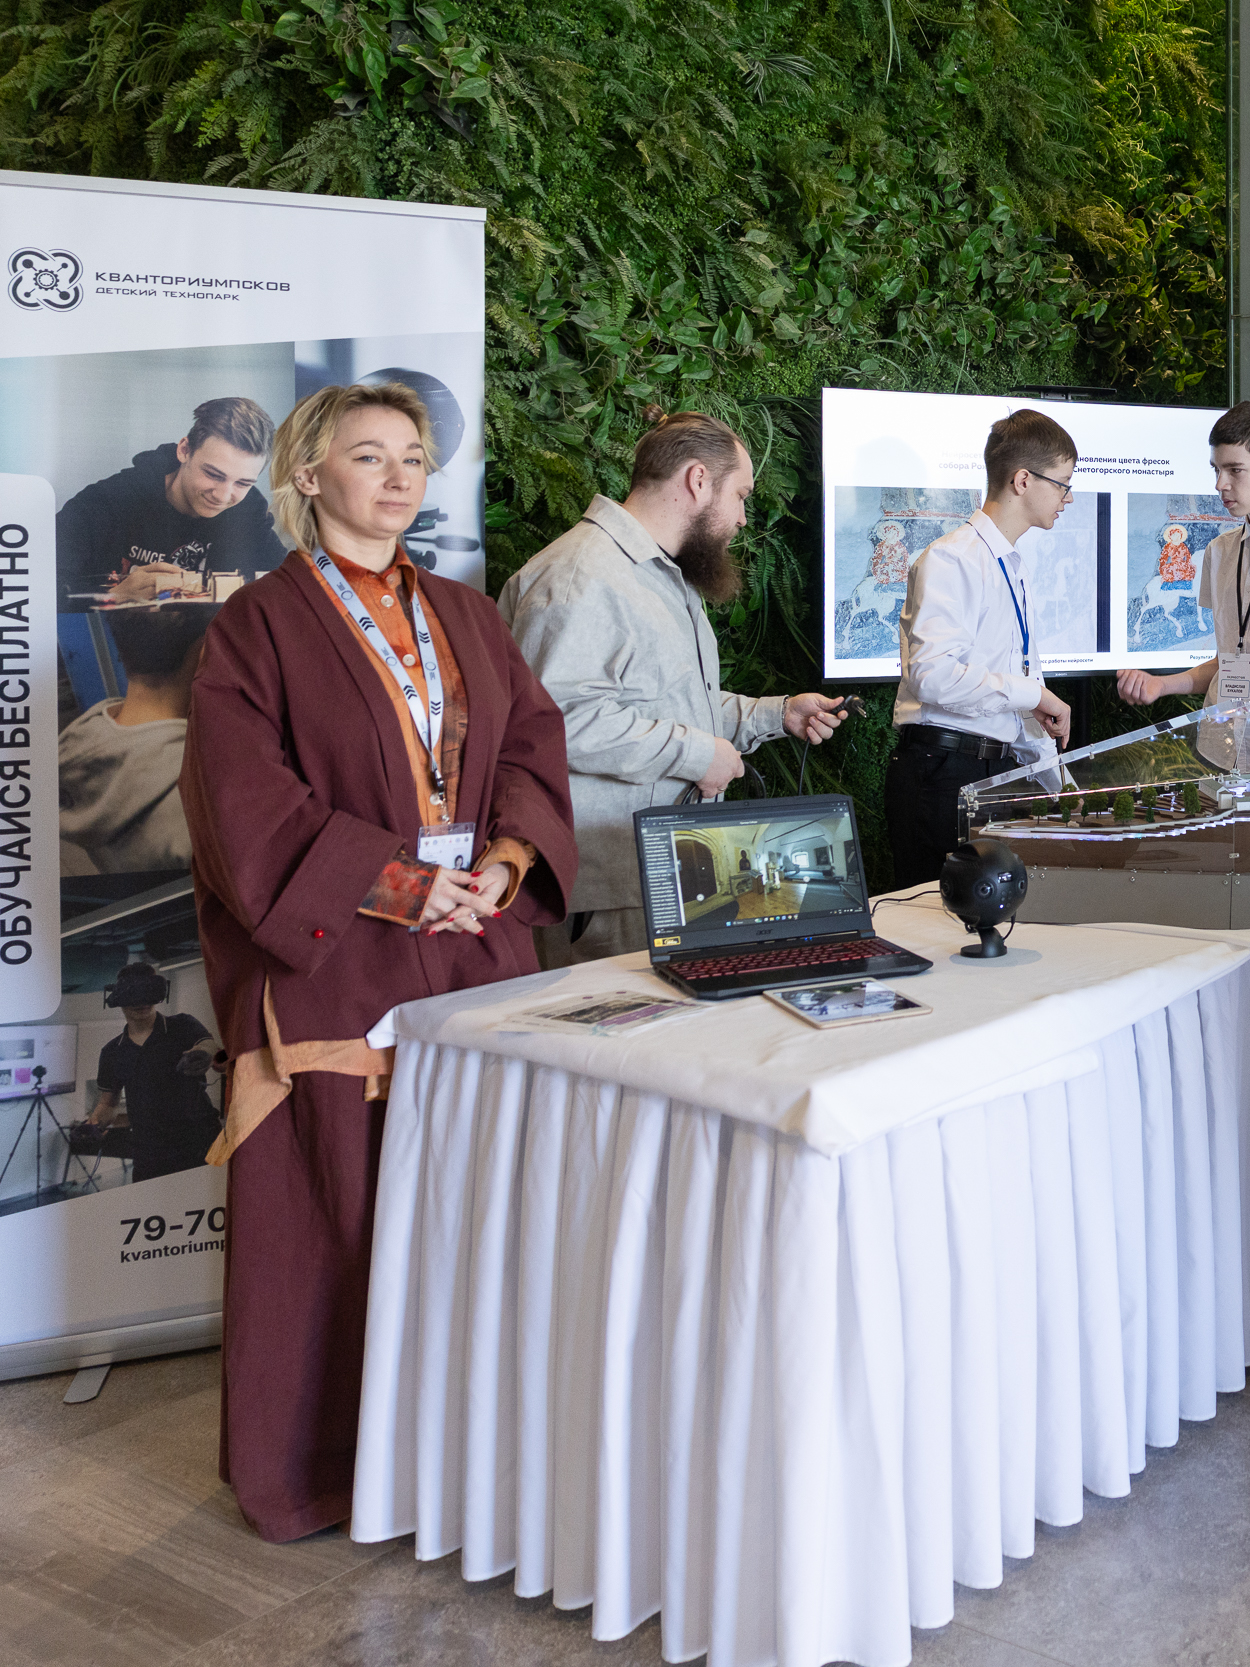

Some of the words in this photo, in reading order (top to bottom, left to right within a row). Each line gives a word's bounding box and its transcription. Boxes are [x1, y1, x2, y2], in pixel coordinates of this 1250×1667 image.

[95, 271, 291, 292] КВАНТОРИУМПСКОВ
[95, 287, 157, 297] ДЕТСКИЙ
[163, 290, 240, 301] ТЕХНОПАРК
[941, 450, 985, 460] Нейросет
[1118, 457, 1141, 465] цвета
[1141, 457, 1170, 466] фресок
[938, 461, 970, 471] собора
[1073, 465, 1131, 475] Снетогорского
[1131, 469, 1175, 477] монастыря
[0, 523, 31, 748] БЕСПЛАТНО
[0, 759, 32, 965] ОБУЧАЙСЯ
[120, 1206, 225, 1246] 79-70
